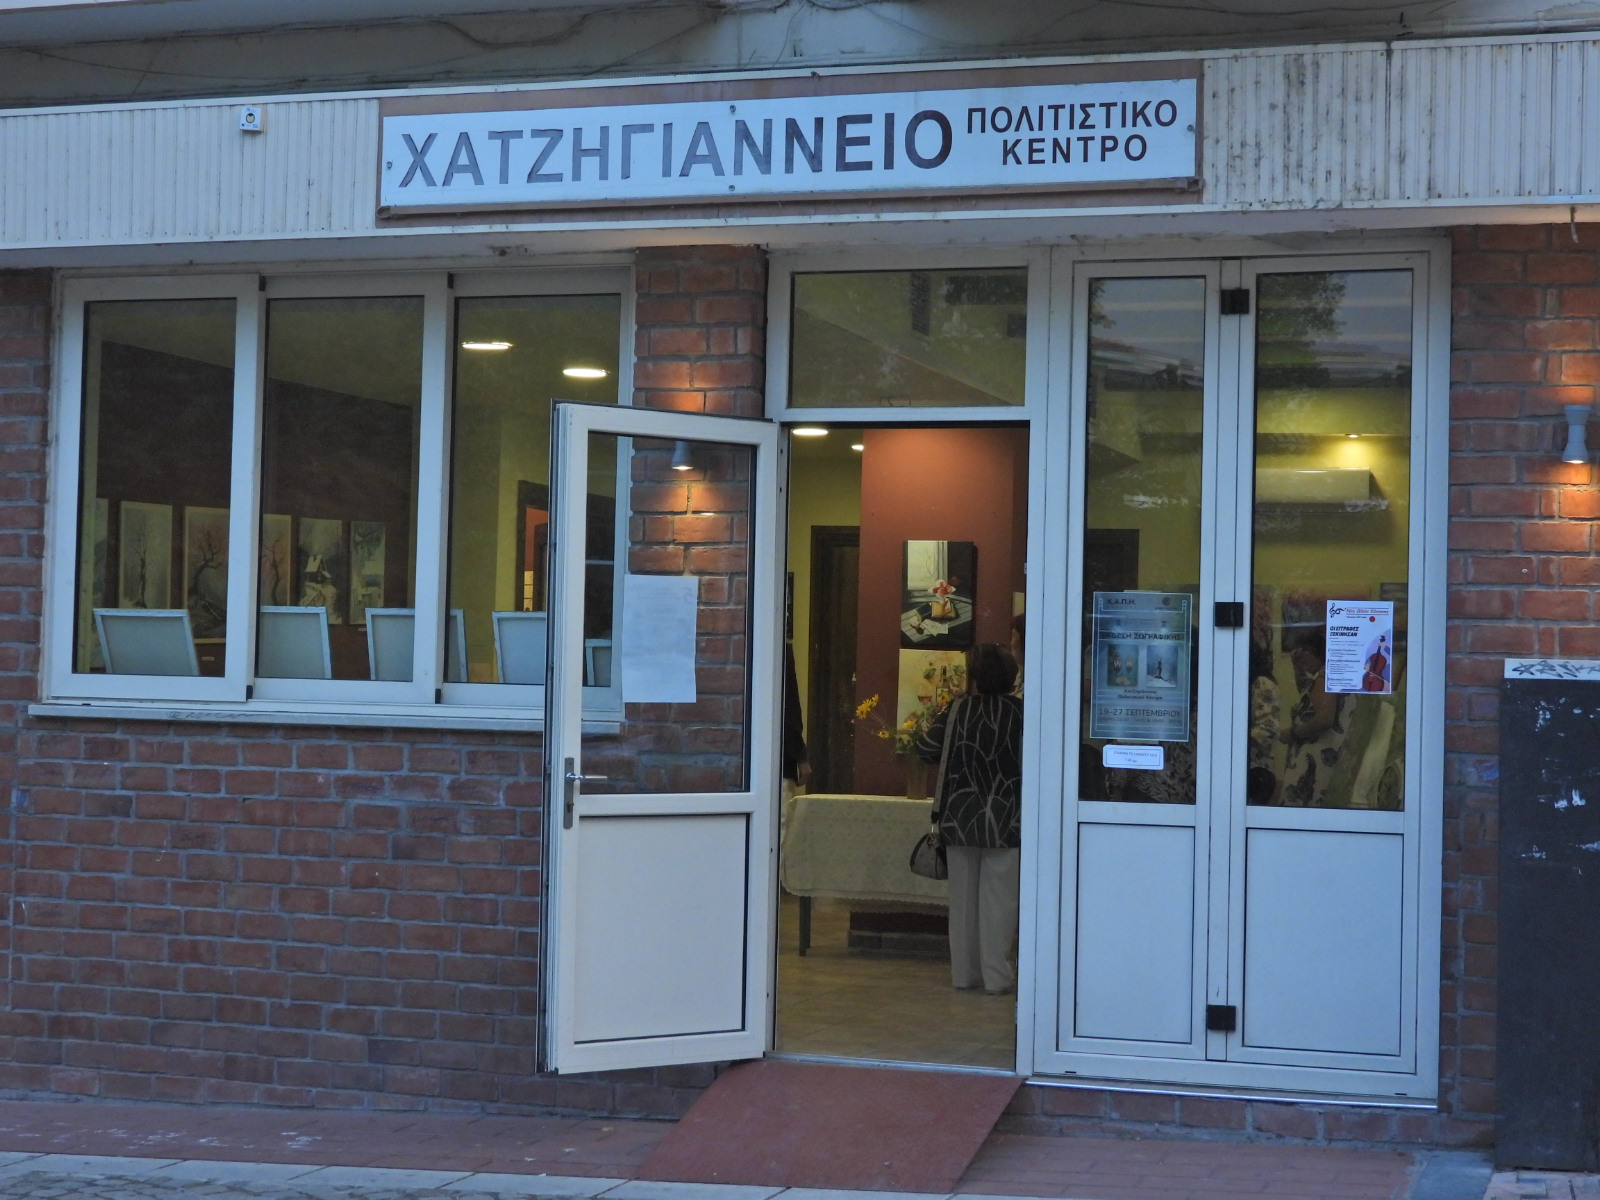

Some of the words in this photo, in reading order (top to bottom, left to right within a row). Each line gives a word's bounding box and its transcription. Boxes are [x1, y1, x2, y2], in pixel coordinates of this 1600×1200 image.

[966, 99, 1178, 134] ΠΟΛΙΤΙΣΤΙΚΟ
[398, 109, 953, 188] ΧΑΤΖΗΓΙΑΝΝΕΙΟ
[1001, 134, 1148, 166] ΚΕΝΤΡΟ
[1125, 708, 1181, 717] ΣΕΠΤΕΜΒΡΙΟΥ
